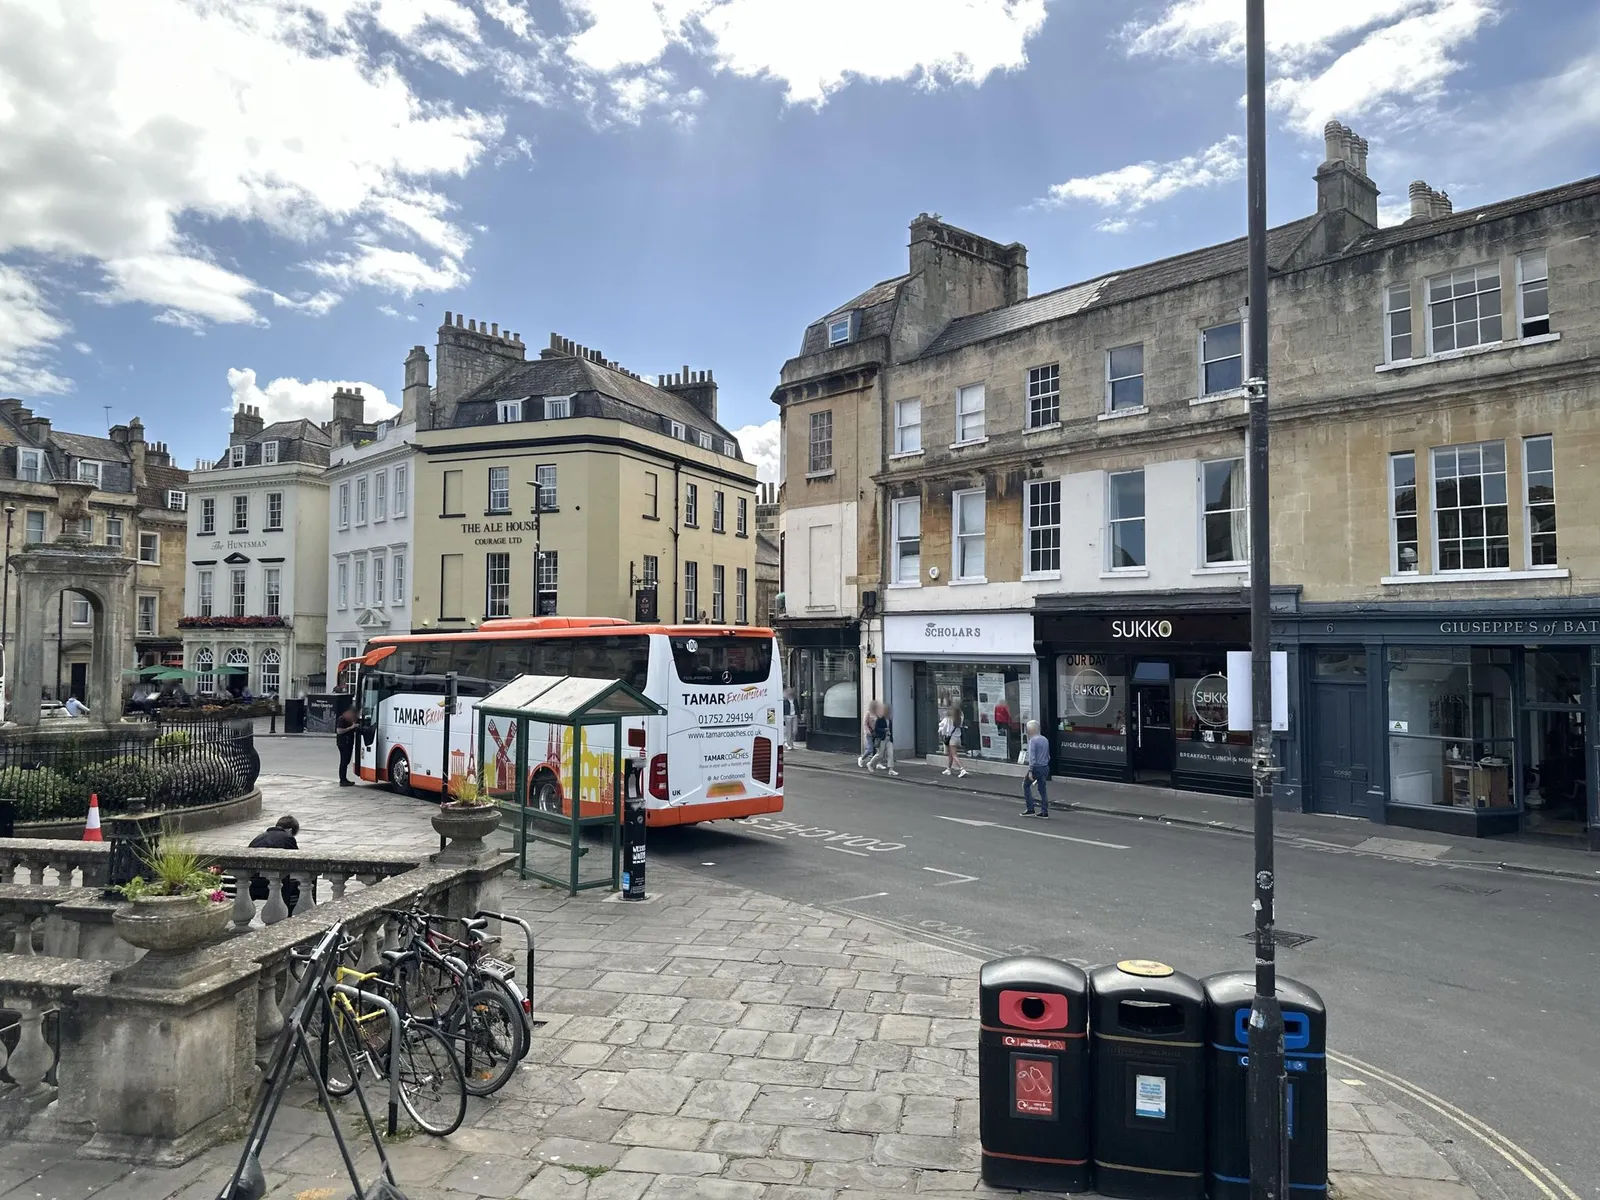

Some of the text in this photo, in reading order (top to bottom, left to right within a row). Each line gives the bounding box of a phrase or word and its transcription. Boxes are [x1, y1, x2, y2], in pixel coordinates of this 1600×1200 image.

[461, 521, 538, 533] THE ALE HOUSE
[211, 540, 268, 550] The HUNTSMAN
[925, 628, 981, 637] SCHOLARS
[1112, 620, 1172, 638] SUKKO
[1327, 623, 1334, 633] 6
[1440, 621, 1538, 632] GIUSEPPE'S
[1543, 621, 1558, 636] of
[687, 641, 698, 650] 100
[1067, 655, 1087, 666] OUR
[682, 694, 726, 705] TAMAR
[1196, 691, 1228, 703] SUKK
[394, 707, 425, 725] TAMAR
[698, 713, 753, 724] 01752 294194
[688, 729, 762, 739] www.tamarcoaches.co.uk
[739, 817, 906, 851] COACHES
